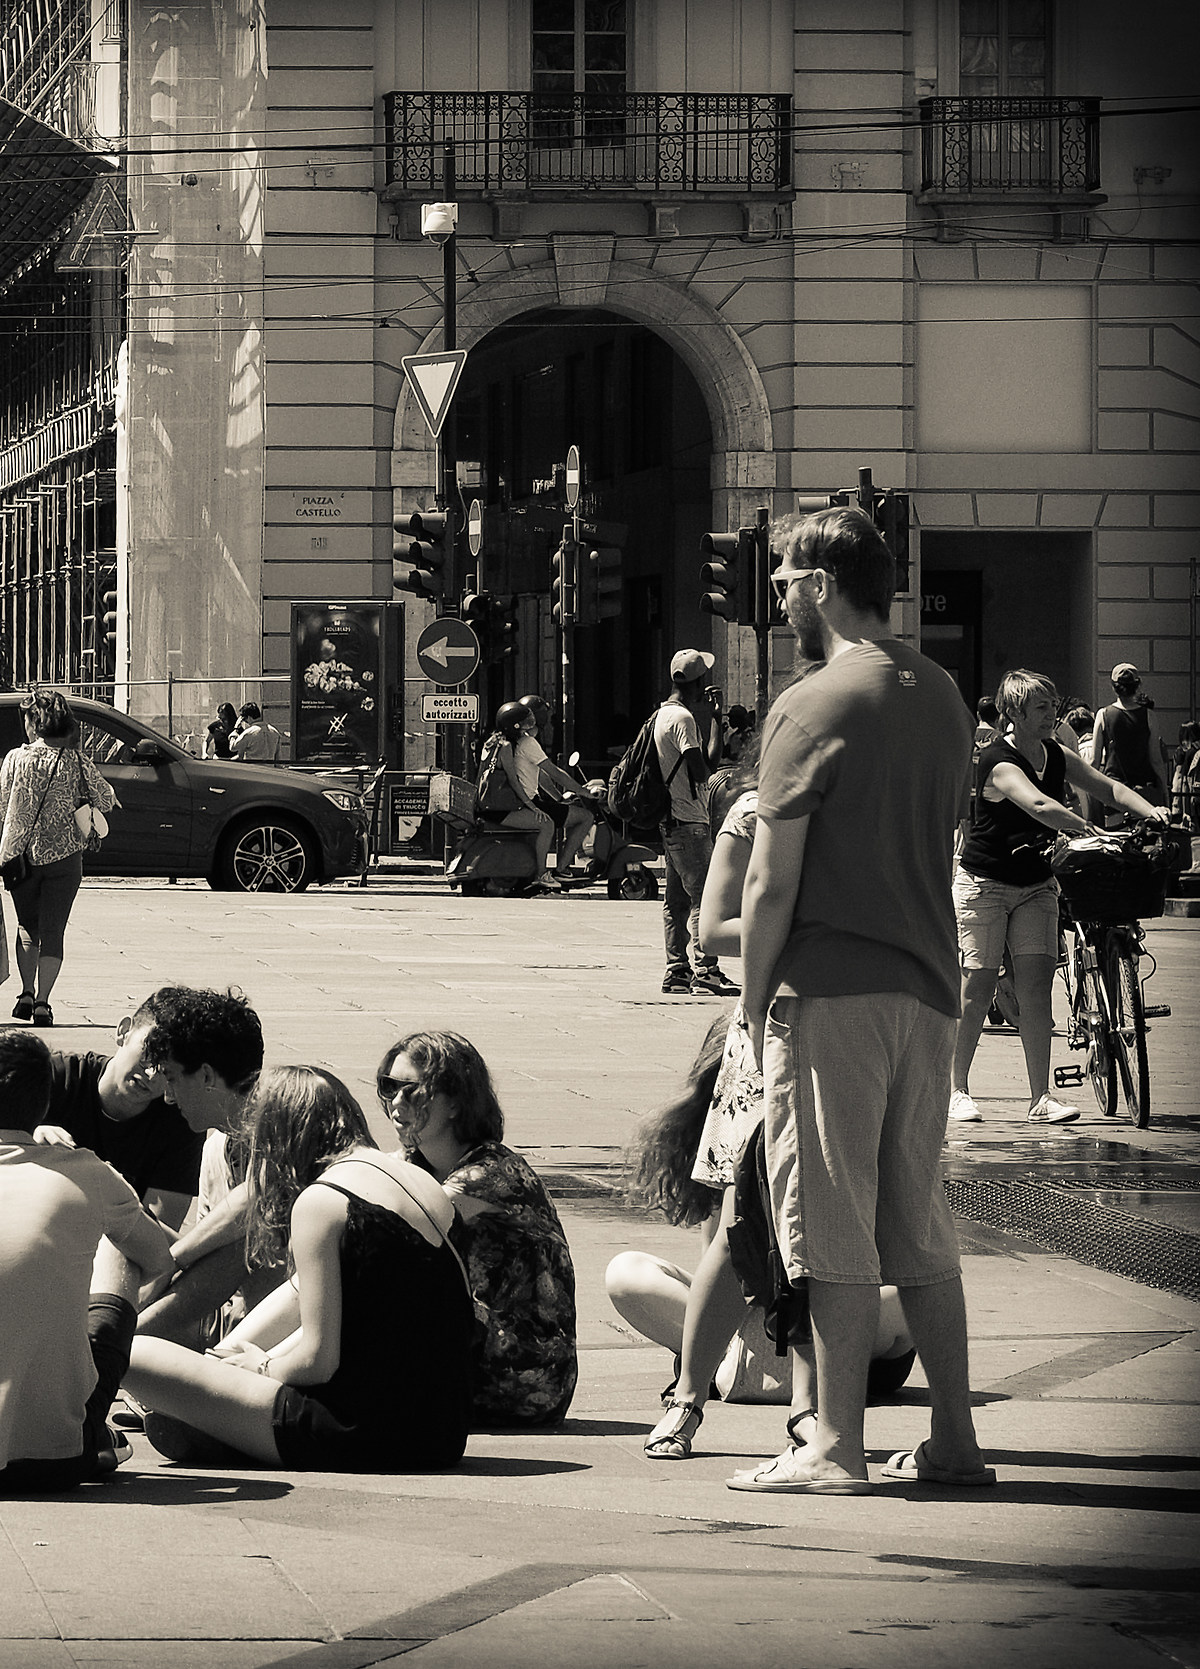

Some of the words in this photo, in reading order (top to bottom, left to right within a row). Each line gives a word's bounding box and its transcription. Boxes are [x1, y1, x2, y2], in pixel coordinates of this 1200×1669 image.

[302, 496, 334, 505] PIAZZA
[295, 508, 342, 517] CASTELLO
[920, 594, 947, 612] re
[433, 697, 468, 707] eccetto
[425, 709, 476, 719] autorizzati
